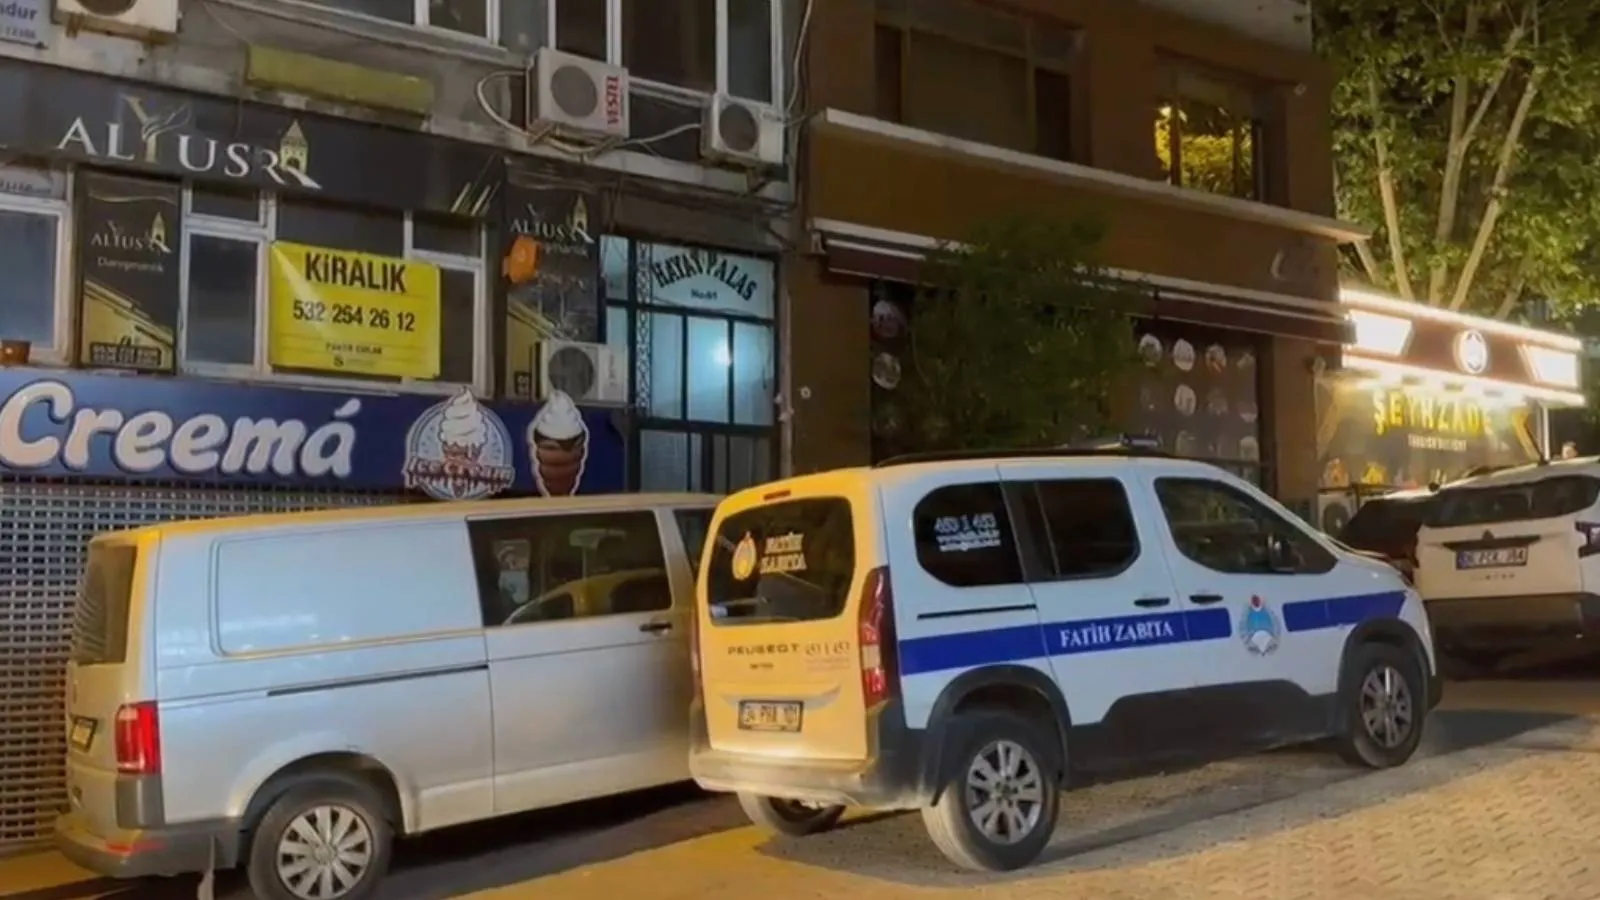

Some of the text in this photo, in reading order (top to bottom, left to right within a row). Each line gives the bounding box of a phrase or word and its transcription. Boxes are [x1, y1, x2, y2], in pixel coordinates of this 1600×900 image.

[704, 250, 758, 301] PALAS
[292, 299, 415, 332] 532 254 26 12
[0, 379, 360, 477] Creemá
[727, 643, 800, 655] PEUGEOT
